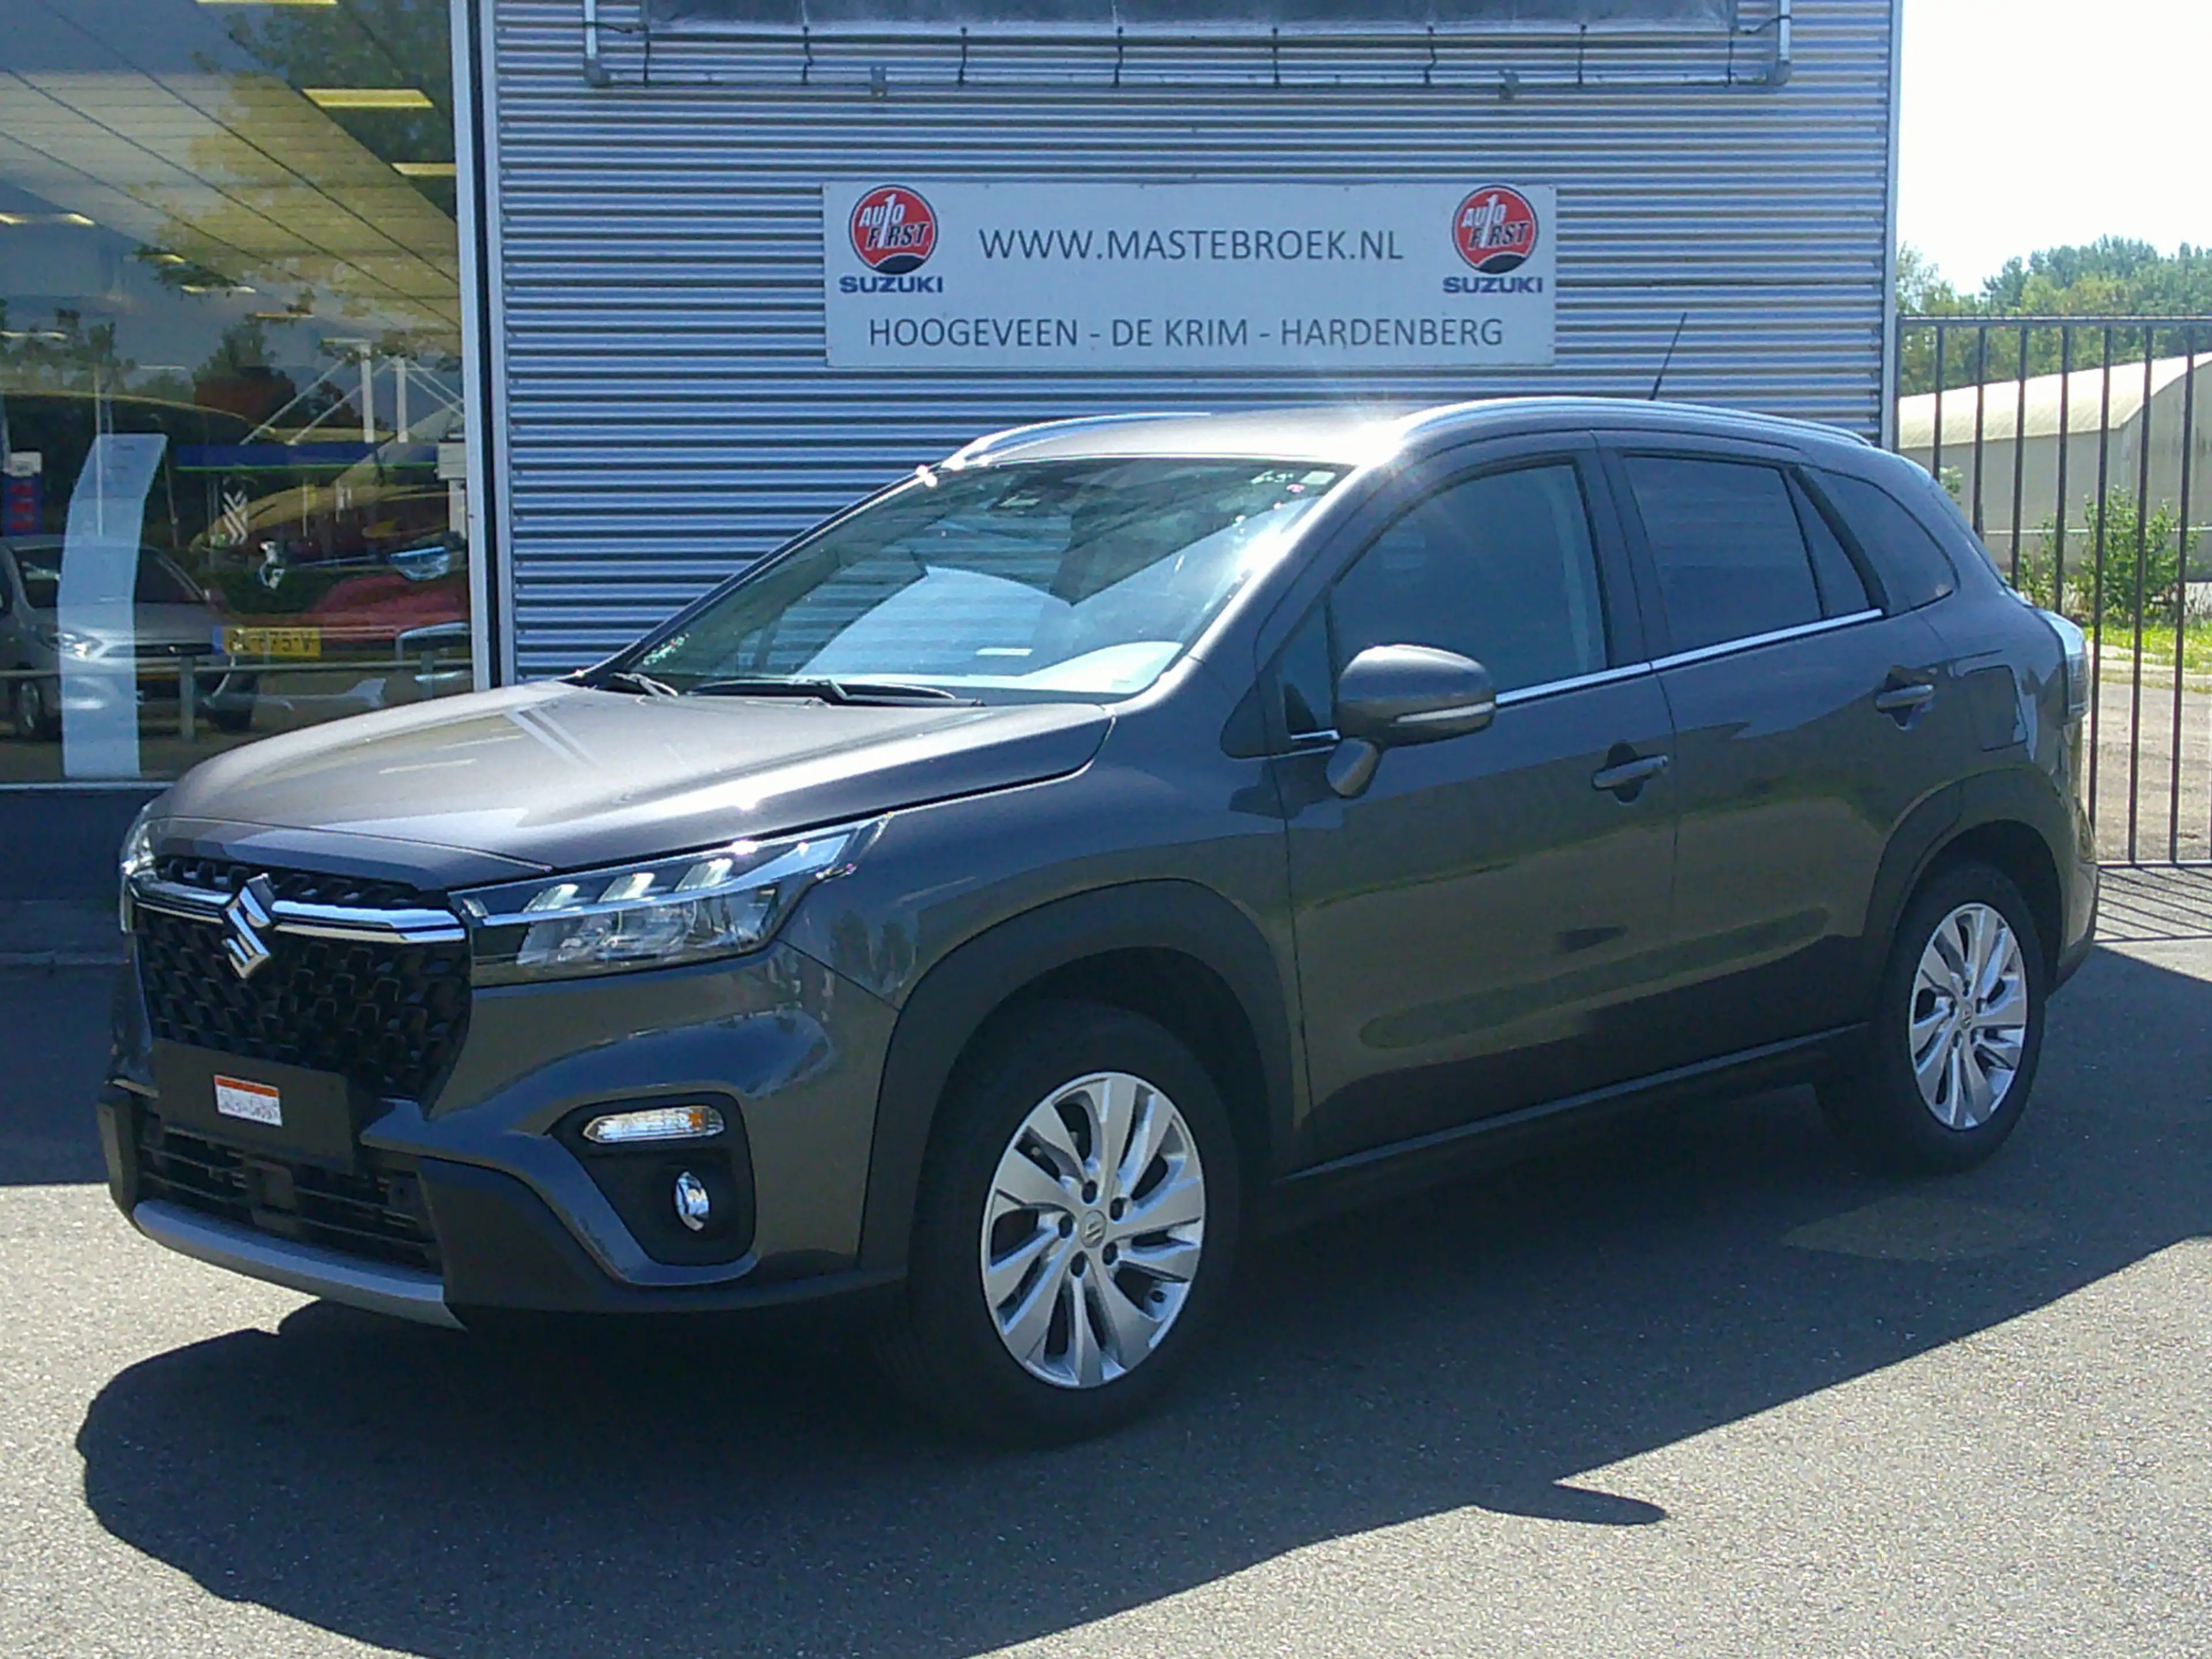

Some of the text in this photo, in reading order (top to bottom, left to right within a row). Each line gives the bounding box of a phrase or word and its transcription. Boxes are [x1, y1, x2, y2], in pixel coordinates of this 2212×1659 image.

[979, 229, 1404, 260] WWW.MASTEBROEK.NL
[840, 276, 943, 294] SUZUKI
[1442, 276, 1544, 294] SUZUKI
[870, 319, 1077, 347] HOOGEVEEN
[1112, 319, 1153, 347] DE
[1165, 319, 1247, 347] KRIM
[1282, 319, 1502, 347] HARDENBERG
